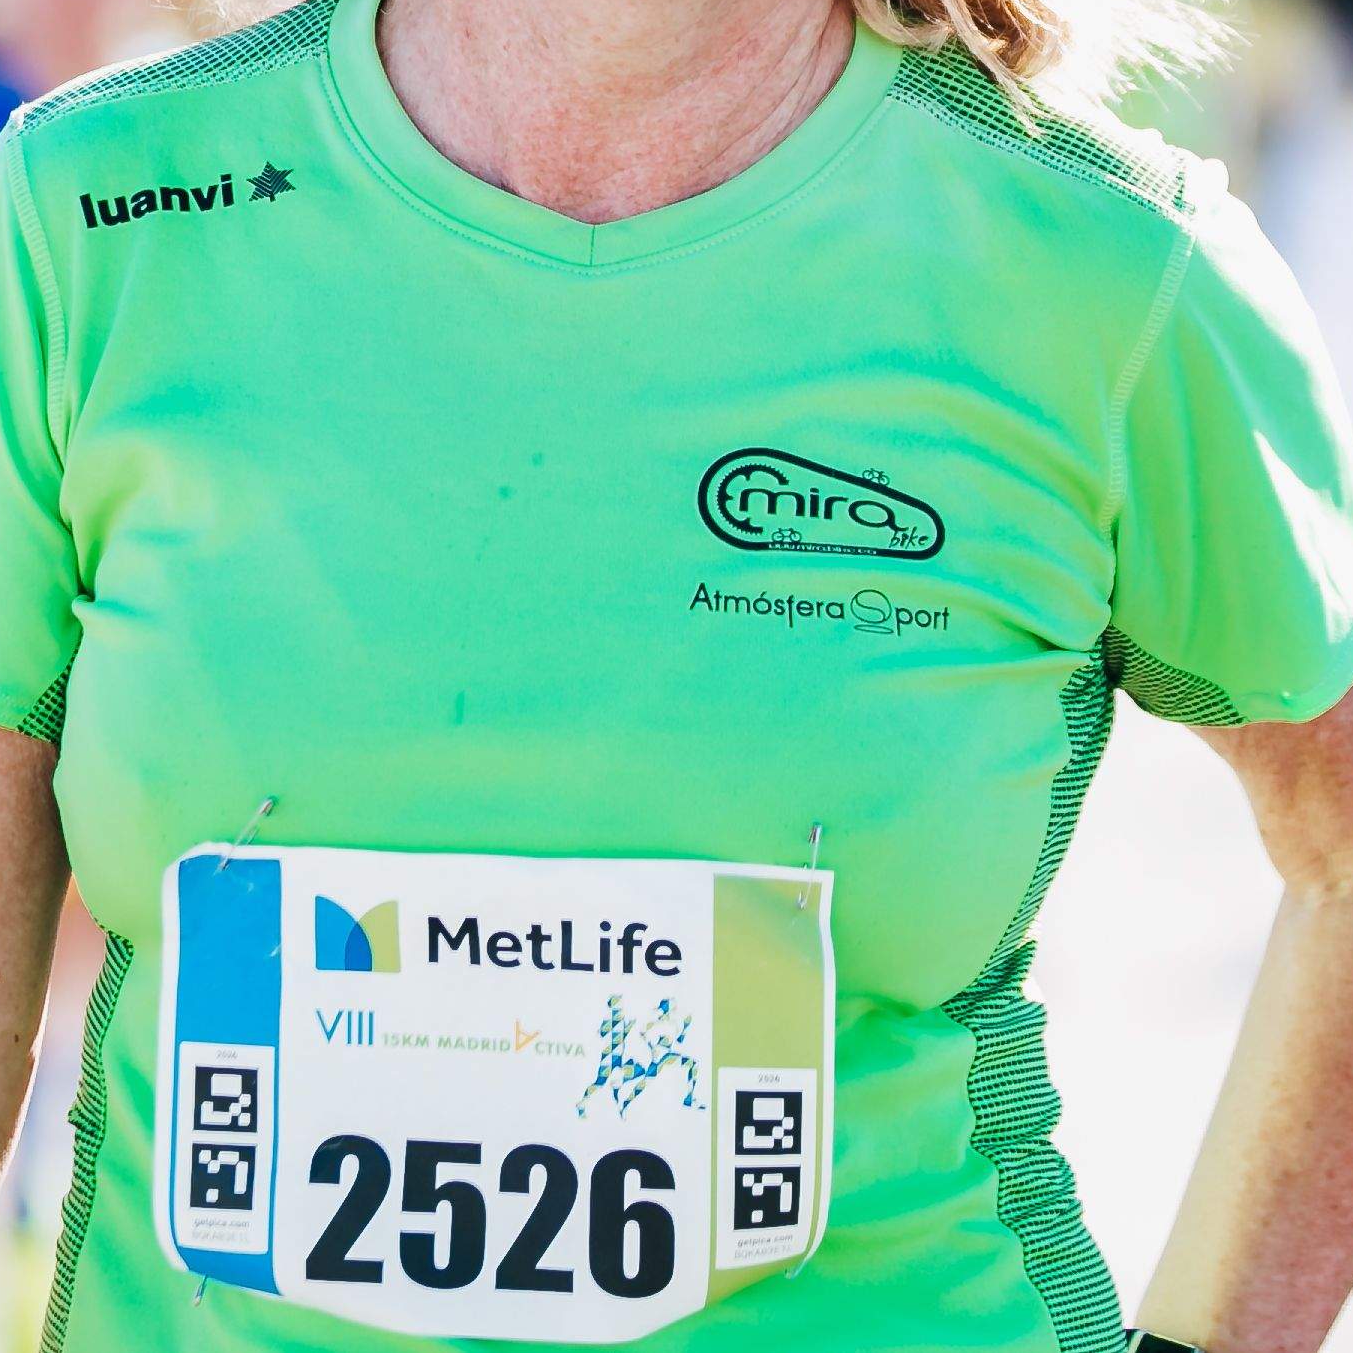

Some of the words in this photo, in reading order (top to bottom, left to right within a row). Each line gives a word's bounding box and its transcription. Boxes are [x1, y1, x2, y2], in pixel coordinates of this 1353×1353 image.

[79, 173, 235, 229] luanvi
[689, 582, 845, 628] Atmósfera
[427, 915, 683, 977] MetLife
[315, 1008, 376, 1046] VIII
[382, 1032, 430, 1049] 15KM
[304, 1133, 676, 1299] 2526
